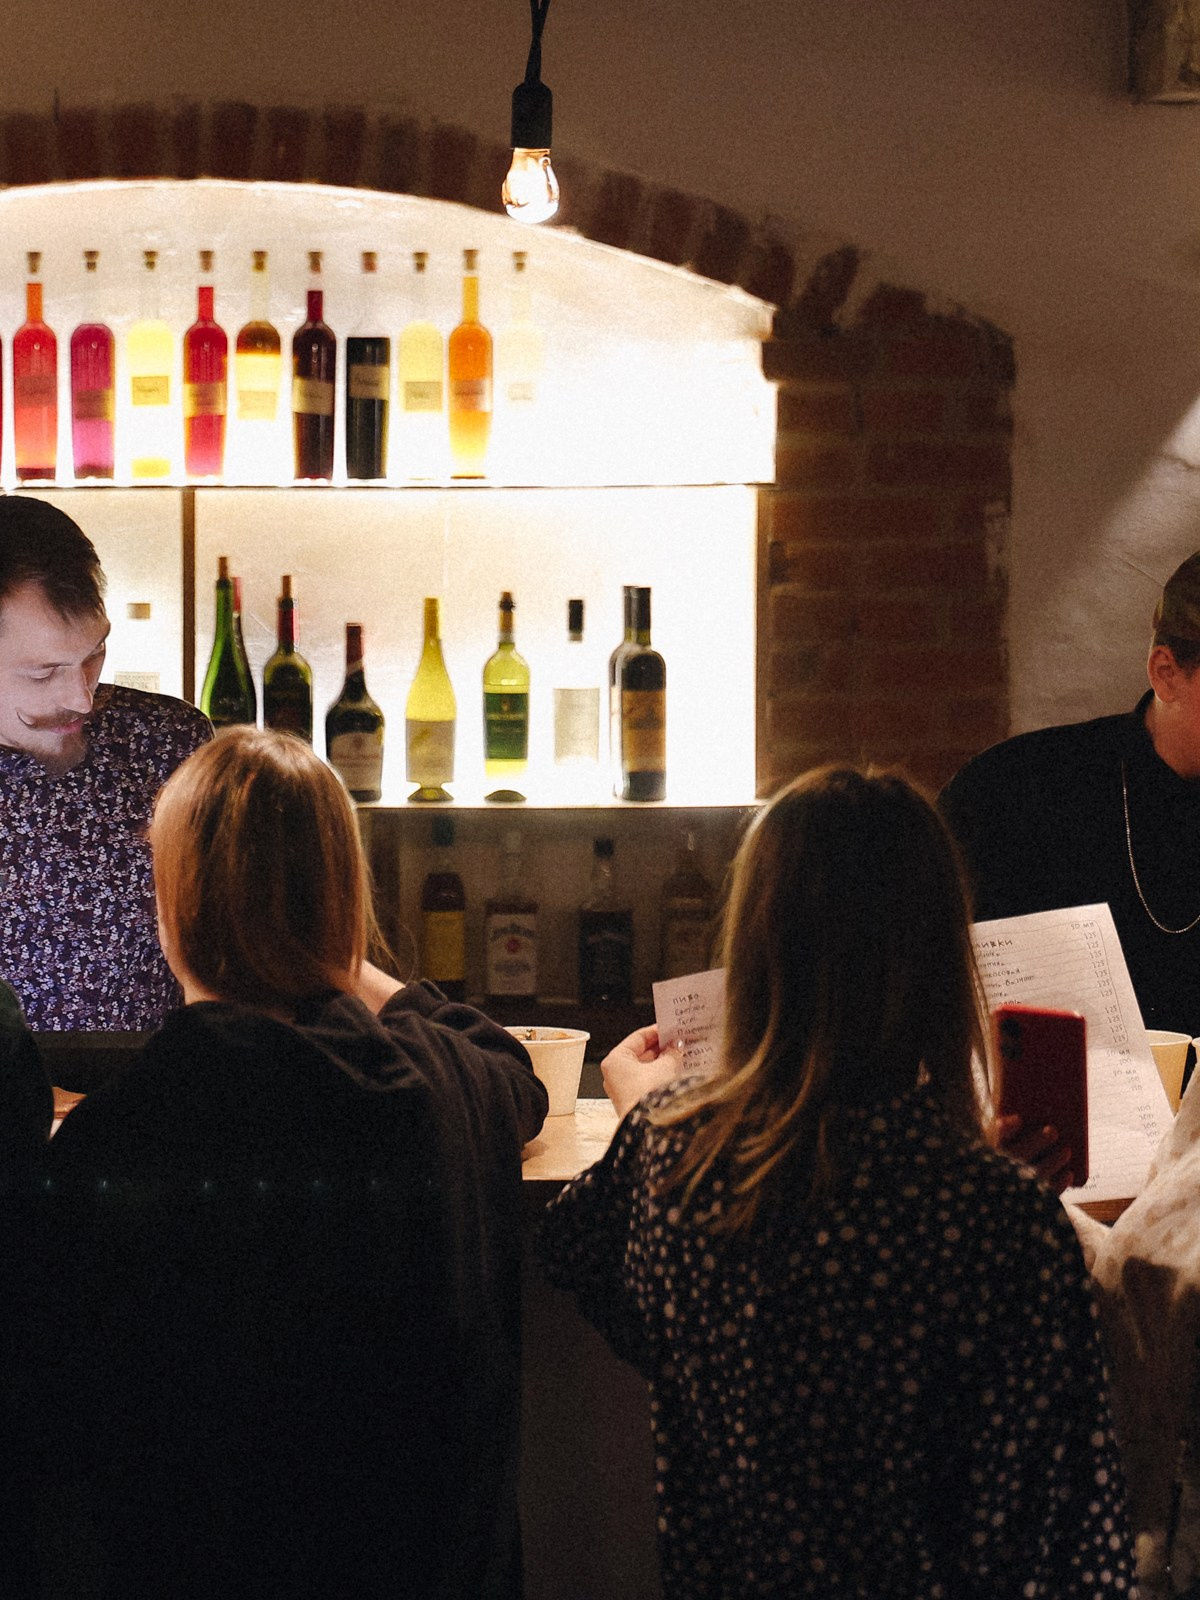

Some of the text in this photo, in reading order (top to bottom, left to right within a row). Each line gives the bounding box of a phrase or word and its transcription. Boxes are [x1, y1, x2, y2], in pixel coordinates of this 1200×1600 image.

[1084, 932, 1096, 940] 125
[1087, 941, 1099, 949] 125
[1090, 950, 1102, 959] 125
[1092, 960, 1105, 968] 125
[1095, 969, 1107, 978] 125
[1097, 979, 1110, 987] 125
[1100, 989, 1112, 997] 125
[1105, 1004, 1117, 1014] 125
[1107, 1015, 1120, 1023] 125
[1110, 1024, 1123, 1033] 125
[1113, 1034, 1126, 1043] 125
